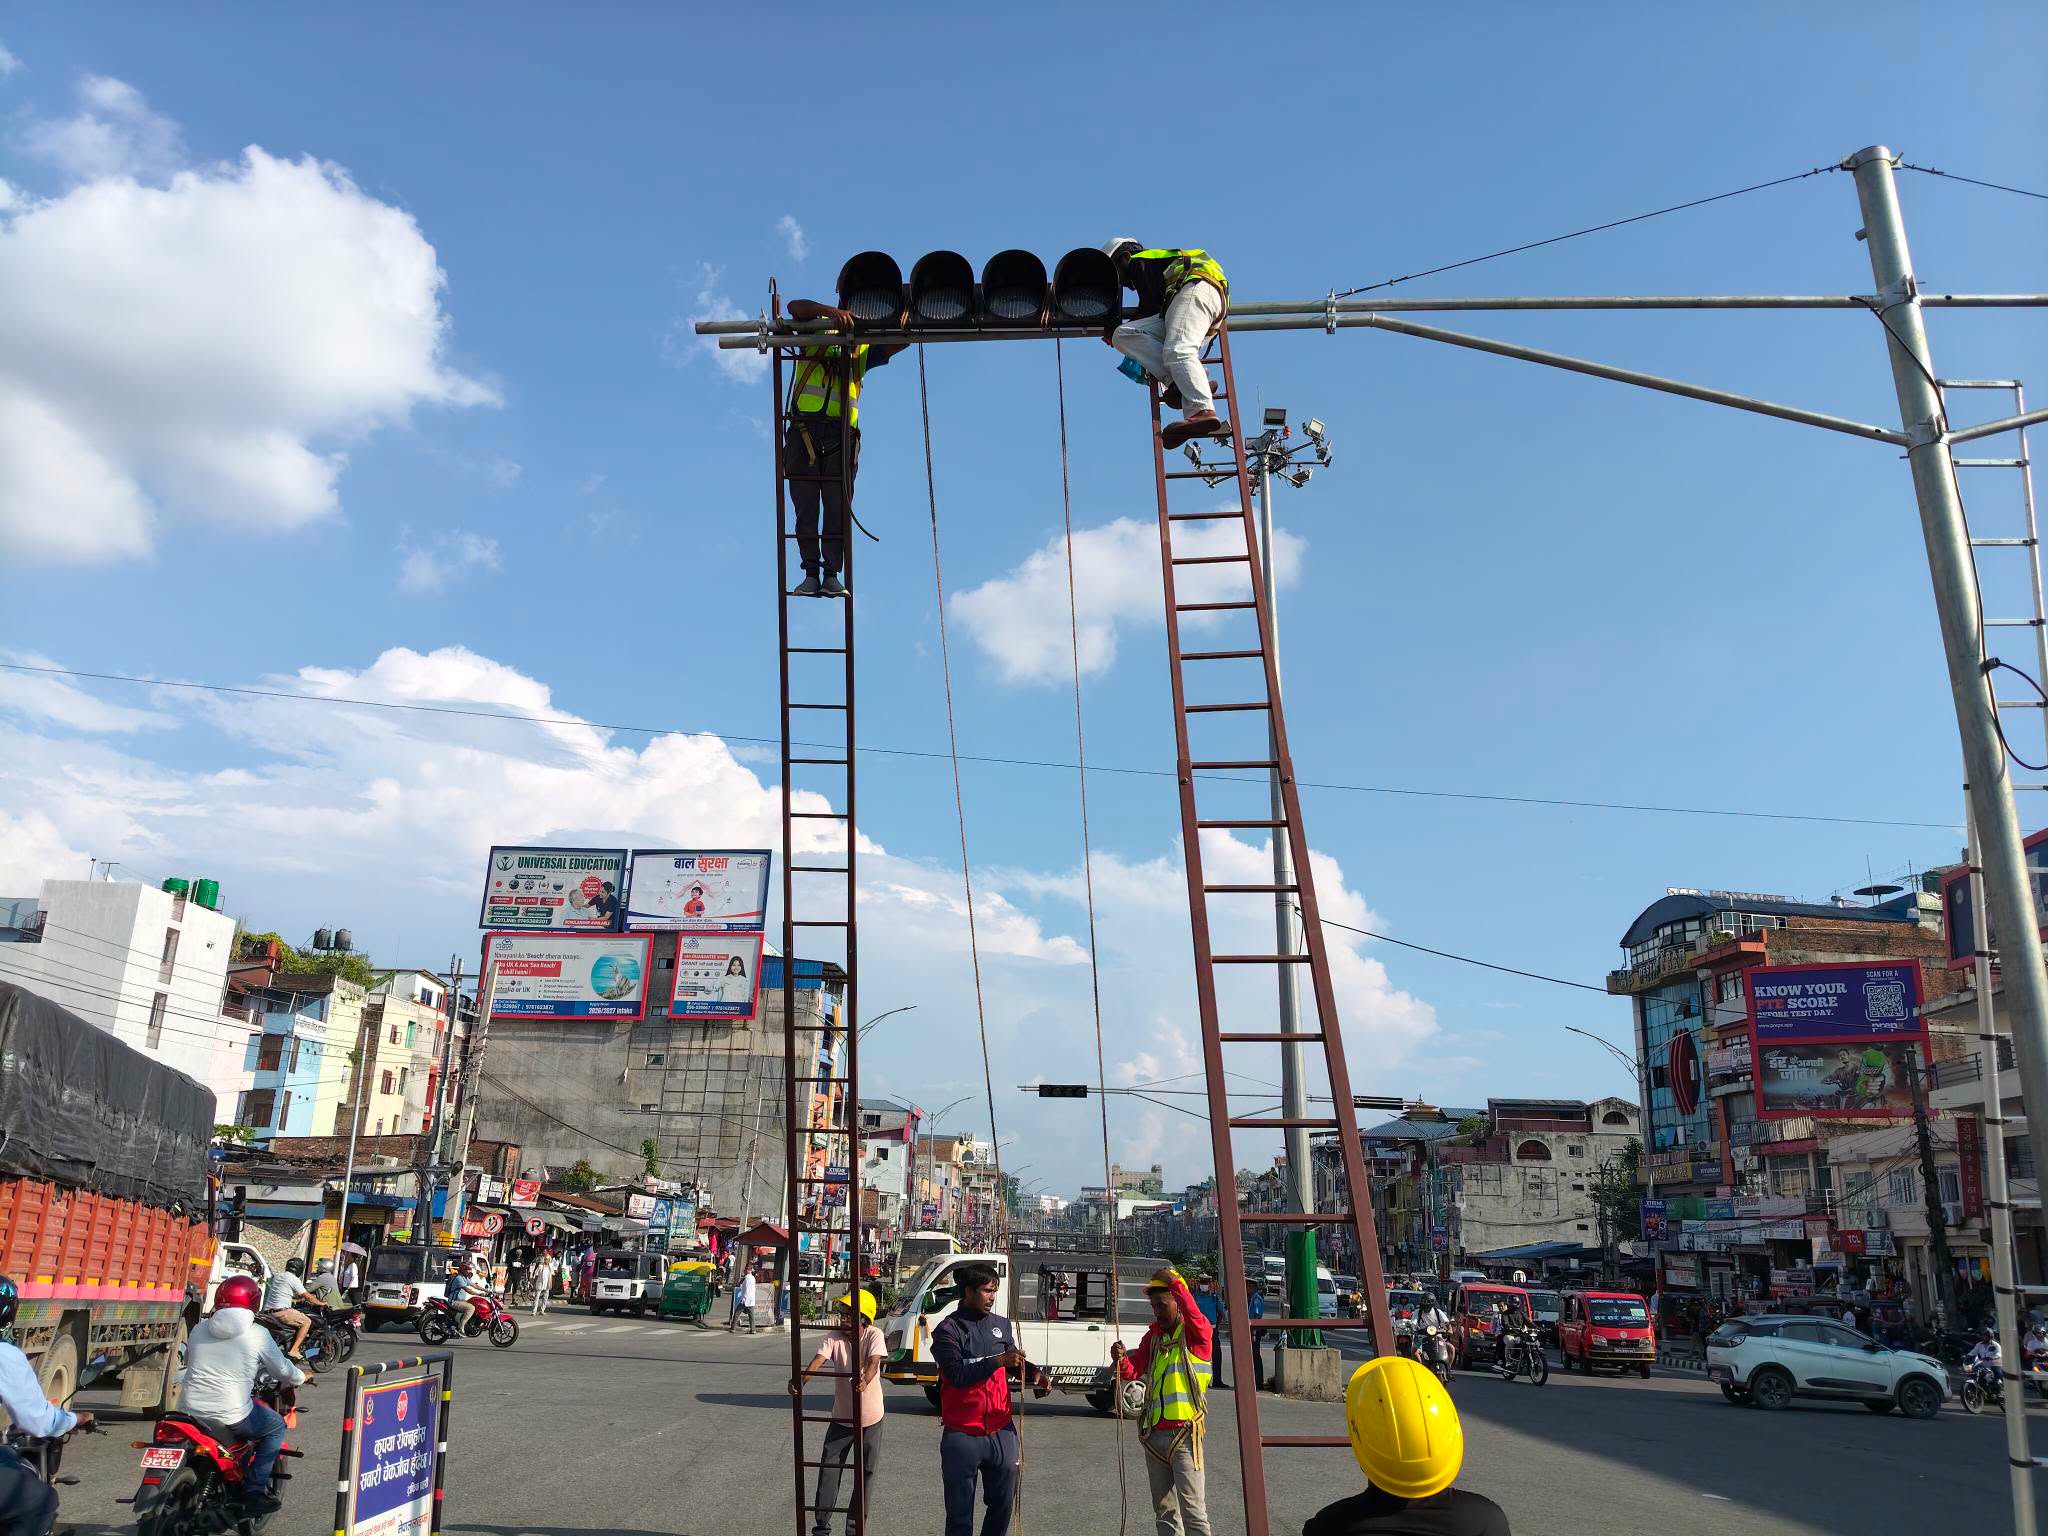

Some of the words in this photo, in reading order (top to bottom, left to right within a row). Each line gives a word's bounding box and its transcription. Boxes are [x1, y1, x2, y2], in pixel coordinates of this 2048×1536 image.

[518, 857, 566, 869] UNIVERSAL
[568, 858, 620, 870] EDUCATION
[674, 858, 696, 869] बाल
[698, 856, 730, 872] सुरक्षा
[1754, 984, 1802, 997] KNOW
[1804, 982, 1848, 995] YOUR
[1756, 998, 1784, 1010] PTE
[1787, 996, 1838, 1008] SCORE
[1872, 1022, 1904, 1032] prepx
[1848, 1234, 1860, 1244] TCL
[1050, 1366, 1098, 1376] RAMNAGAR
[374, 1435, 396, 1460] कृपया
[360, 1464, 382, 1492] सवारी
